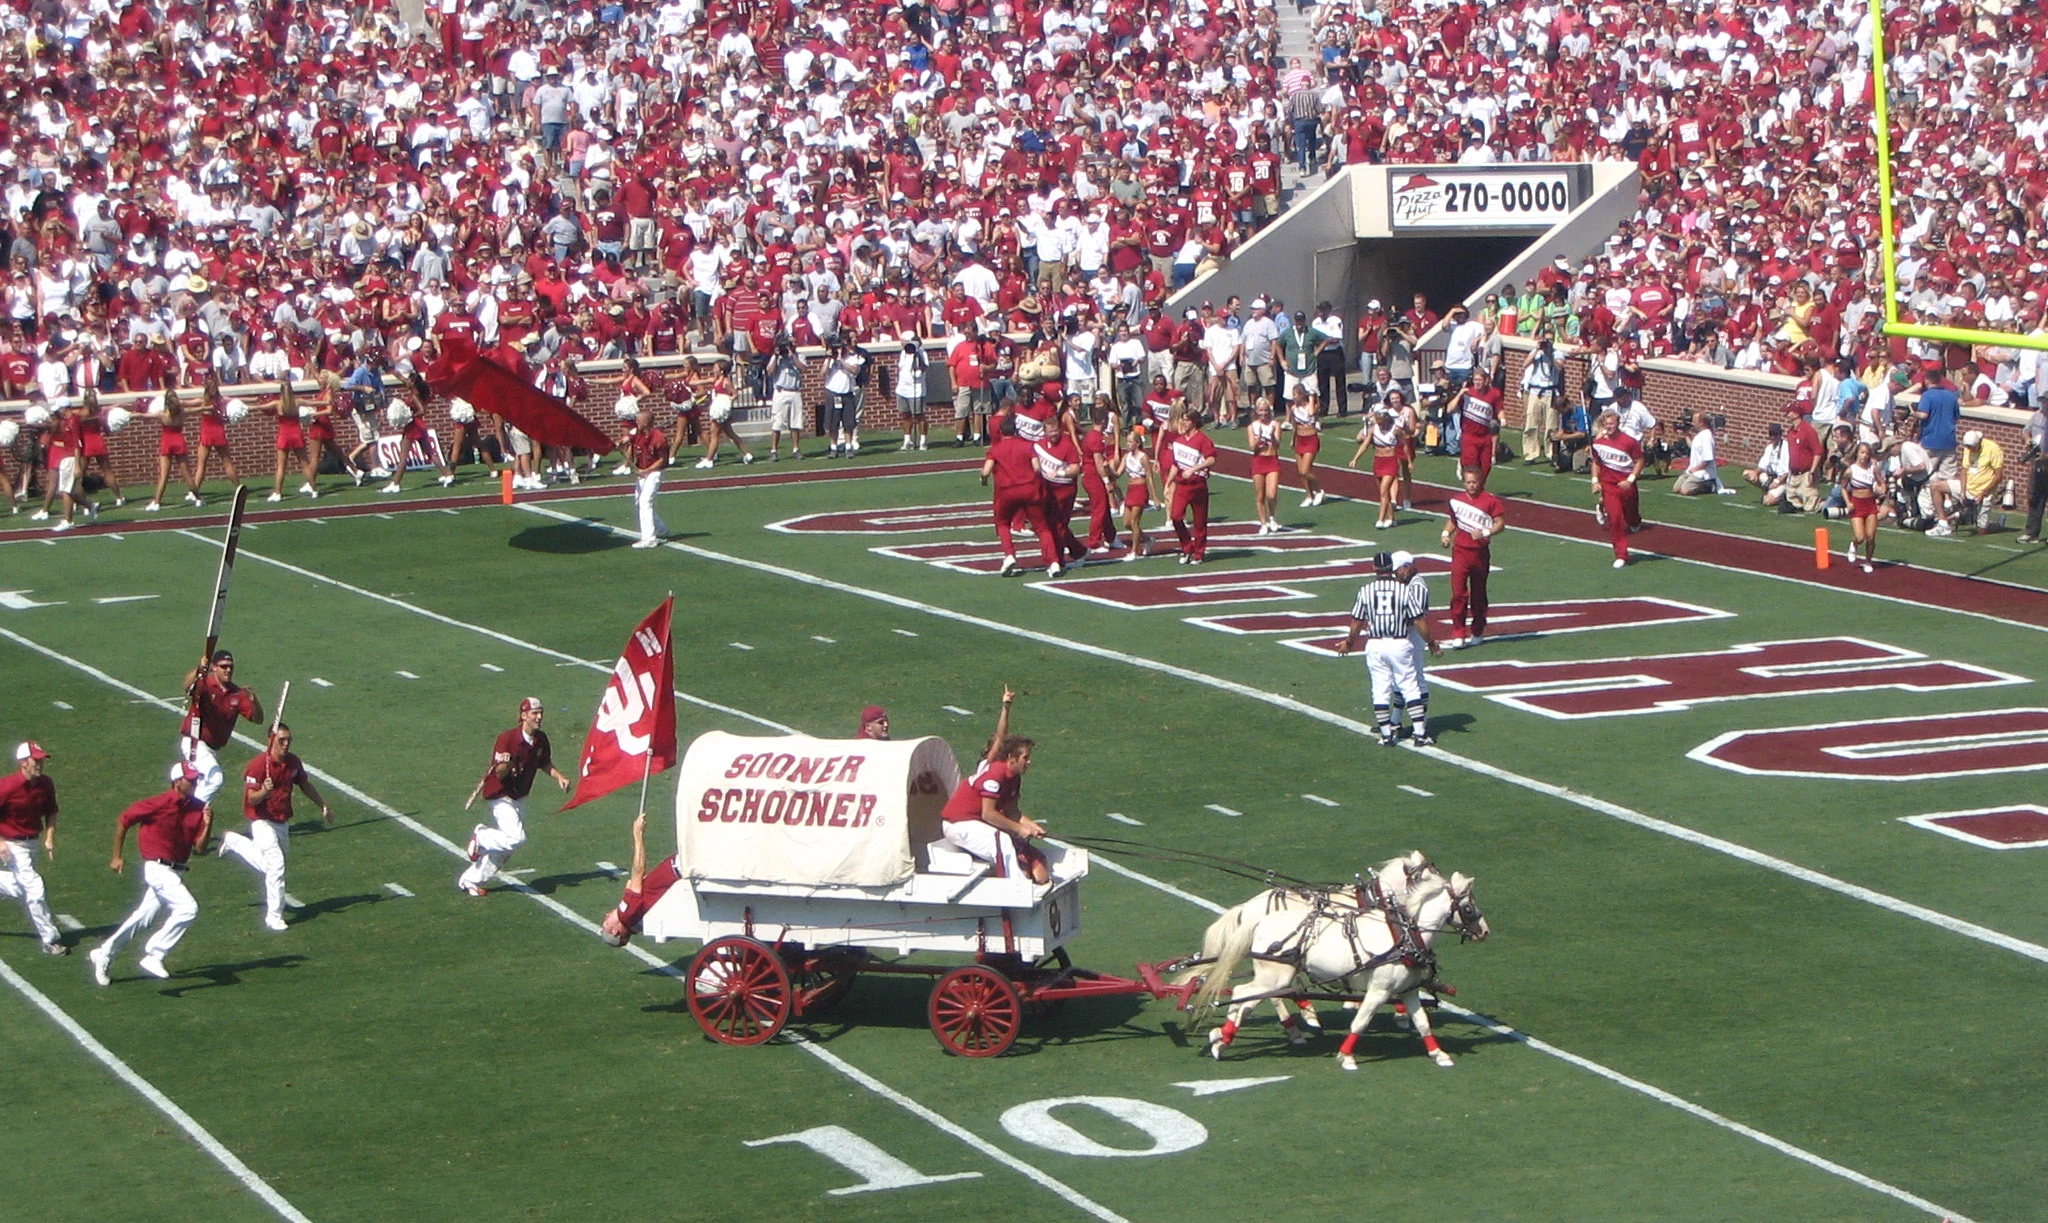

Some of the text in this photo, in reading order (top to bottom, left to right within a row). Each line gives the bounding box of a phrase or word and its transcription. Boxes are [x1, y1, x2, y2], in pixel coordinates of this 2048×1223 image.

[1255, 165, 1269, 180] 20
[1396, 181, 1566, 220] Pizza Hut 270-0000
[1376, 590, 1394, 615] H
[724, 752, 865, 784] SOONER
